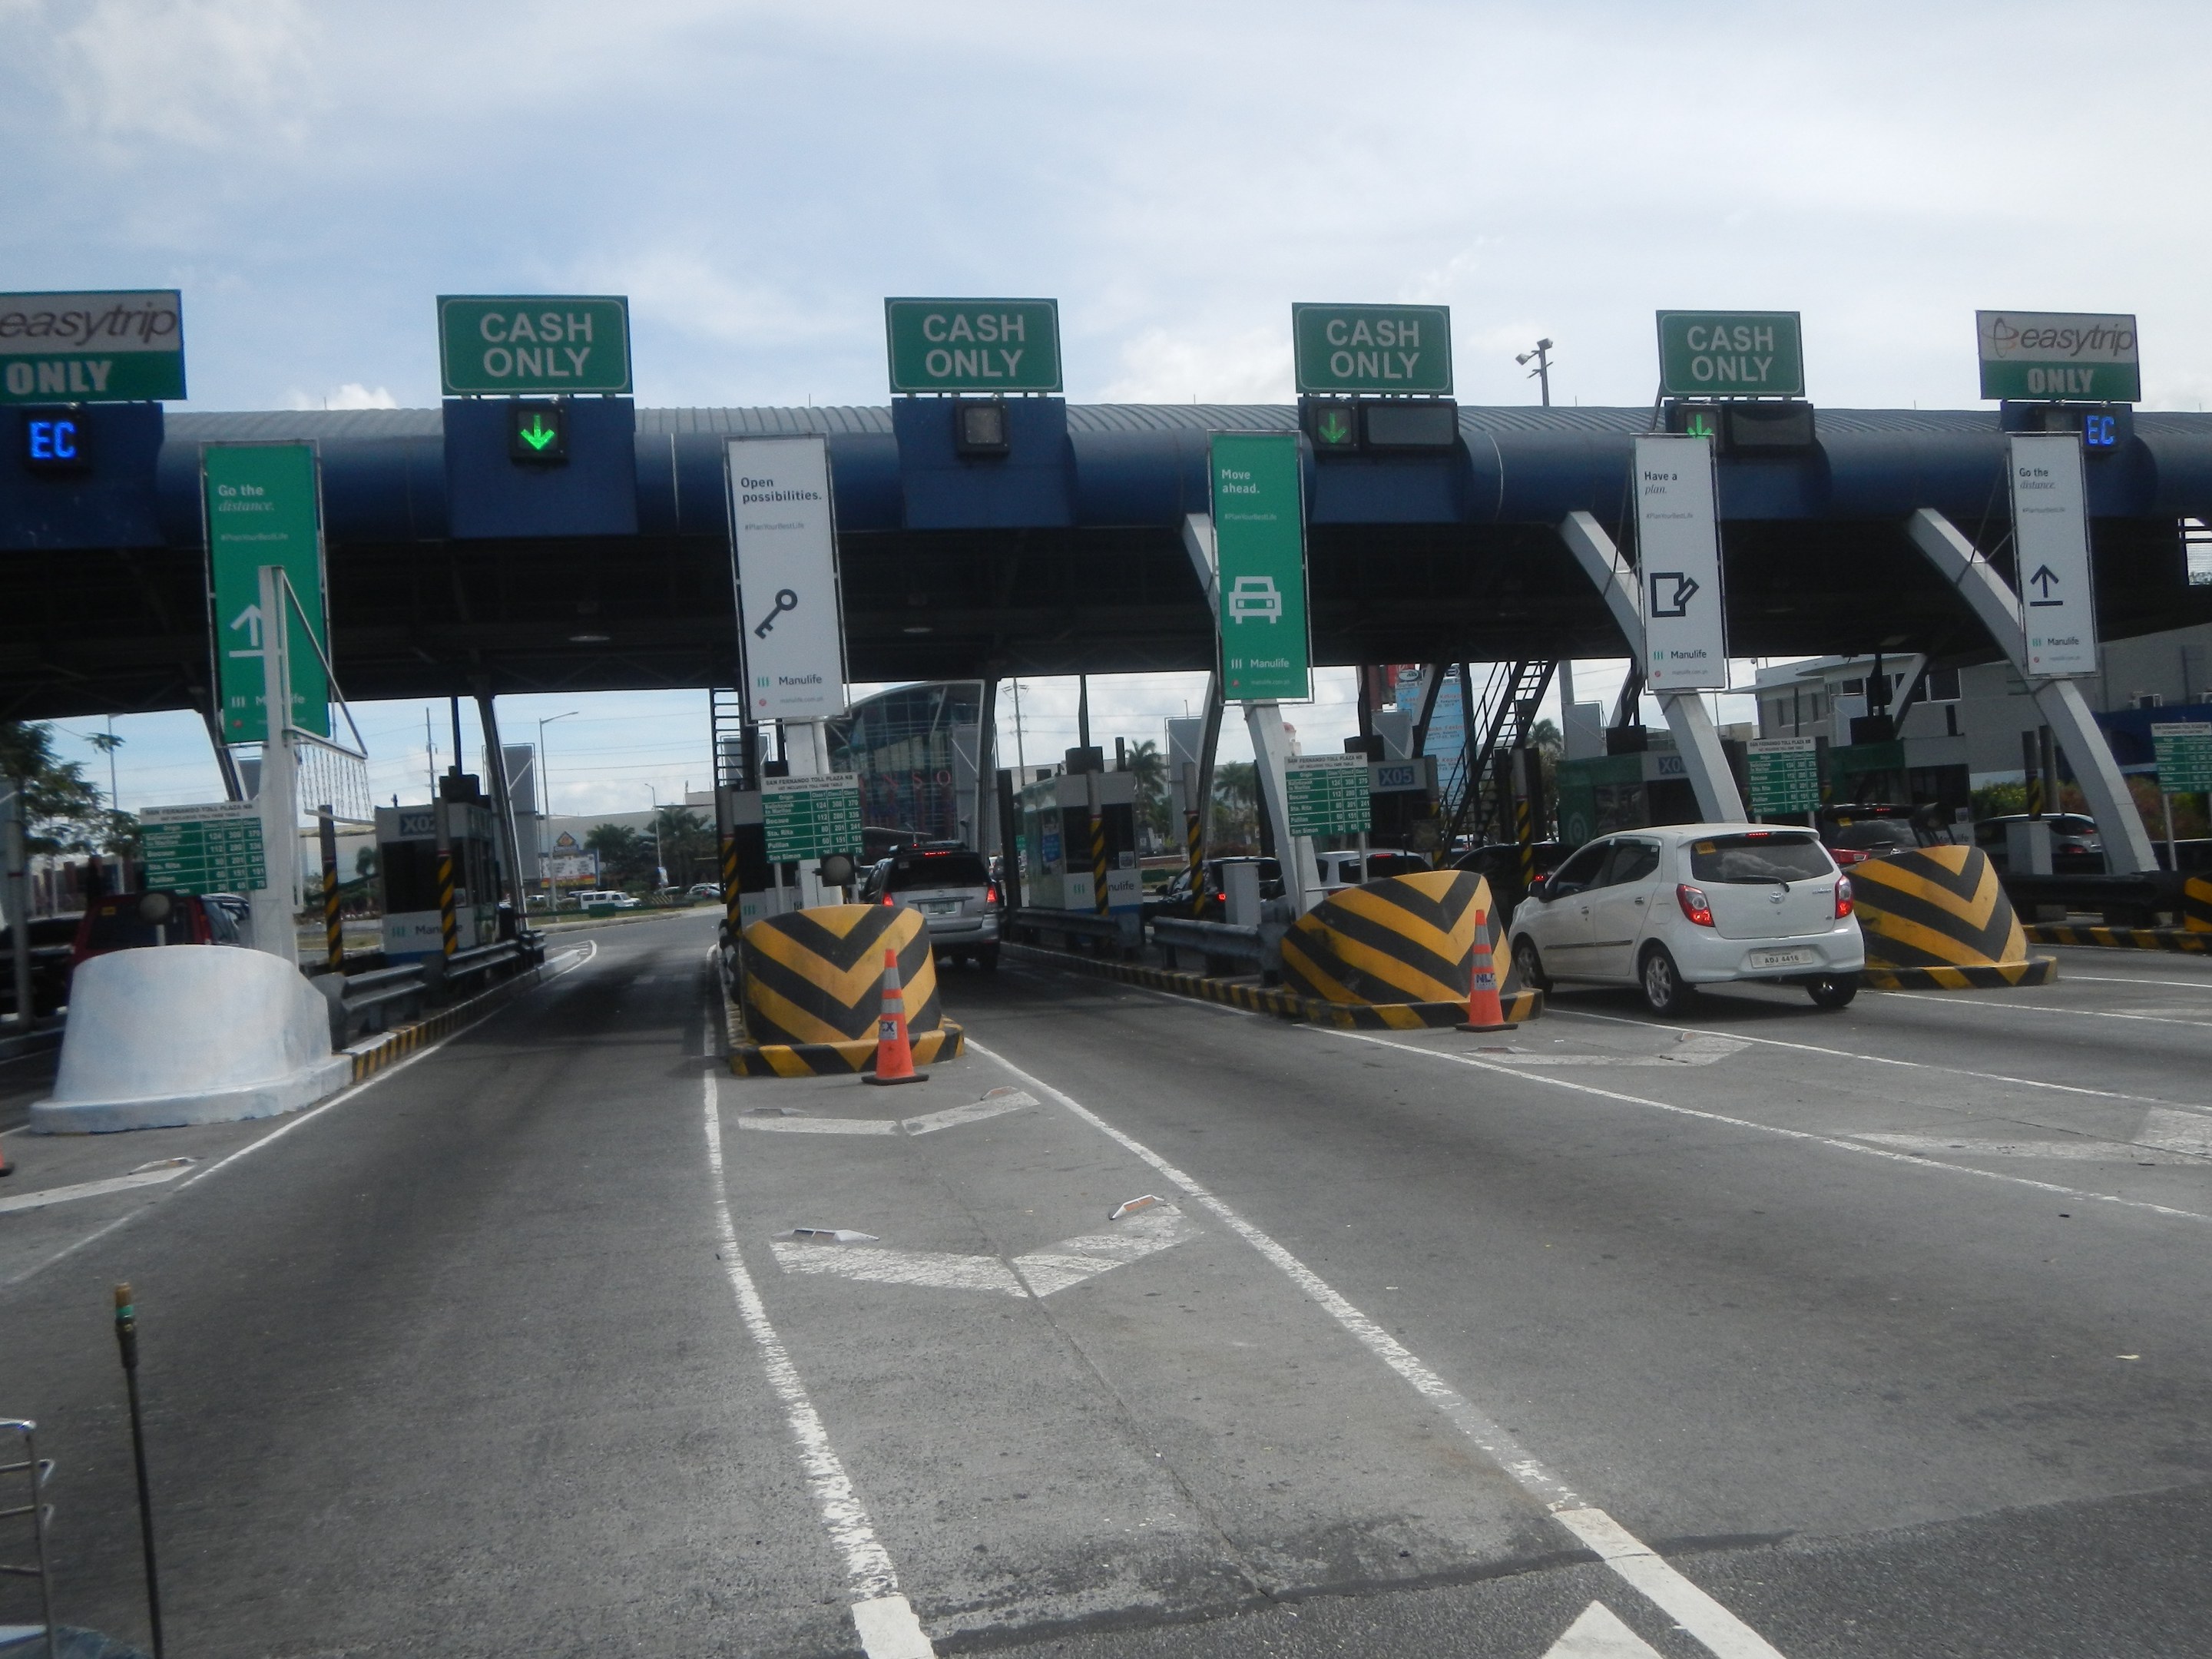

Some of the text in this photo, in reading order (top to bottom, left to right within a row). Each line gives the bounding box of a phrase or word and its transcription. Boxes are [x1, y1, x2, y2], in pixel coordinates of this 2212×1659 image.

[0, 302, 177, 346] easytrip
[480, 313, 592, 343] CASH
[923, 314, 1025, 343] CASH
[1326, 320, 1420, 347] CASH
[1687, 326, 1774, 352] CASH
[2020, 323, 2135, 356] easytrip
[483, 347, 591, 377] ONLY
[926, 349, 1024, 378] ONLY
[1330, 351, 1420, 379] ONLY
[1691, 356, 1773, 382] ONLY
[6, 361, 113, 395] ONLY
[2028, 368, 2094, 394] ONLY
[29, 421, 75, 459] EC
[2087, 416, 2114, 445] EC
[740, 477, 773, 489] Open
[1221, 469, 1250, 479] Move
[1644, 471, 1669, 481] Have
[2019, 468, 2048, 477] Go the
[218, 485, 264, 496] Go the
[743, 490, 822, 505] possibilities.
[1223, 483, 1260, 493] ahead.
[2048, 637, 2079, 646] Manulife
[1250, 658, 1290, 667] Manulife
[1671, 650, 1707, 659] Manulife
[779, 674, 823, 685] Manulife
[1661, 757, 1681, 773] X0
[1381, 768, 1412, 784] X05
[1108, 881, 1134, 892] nulife
